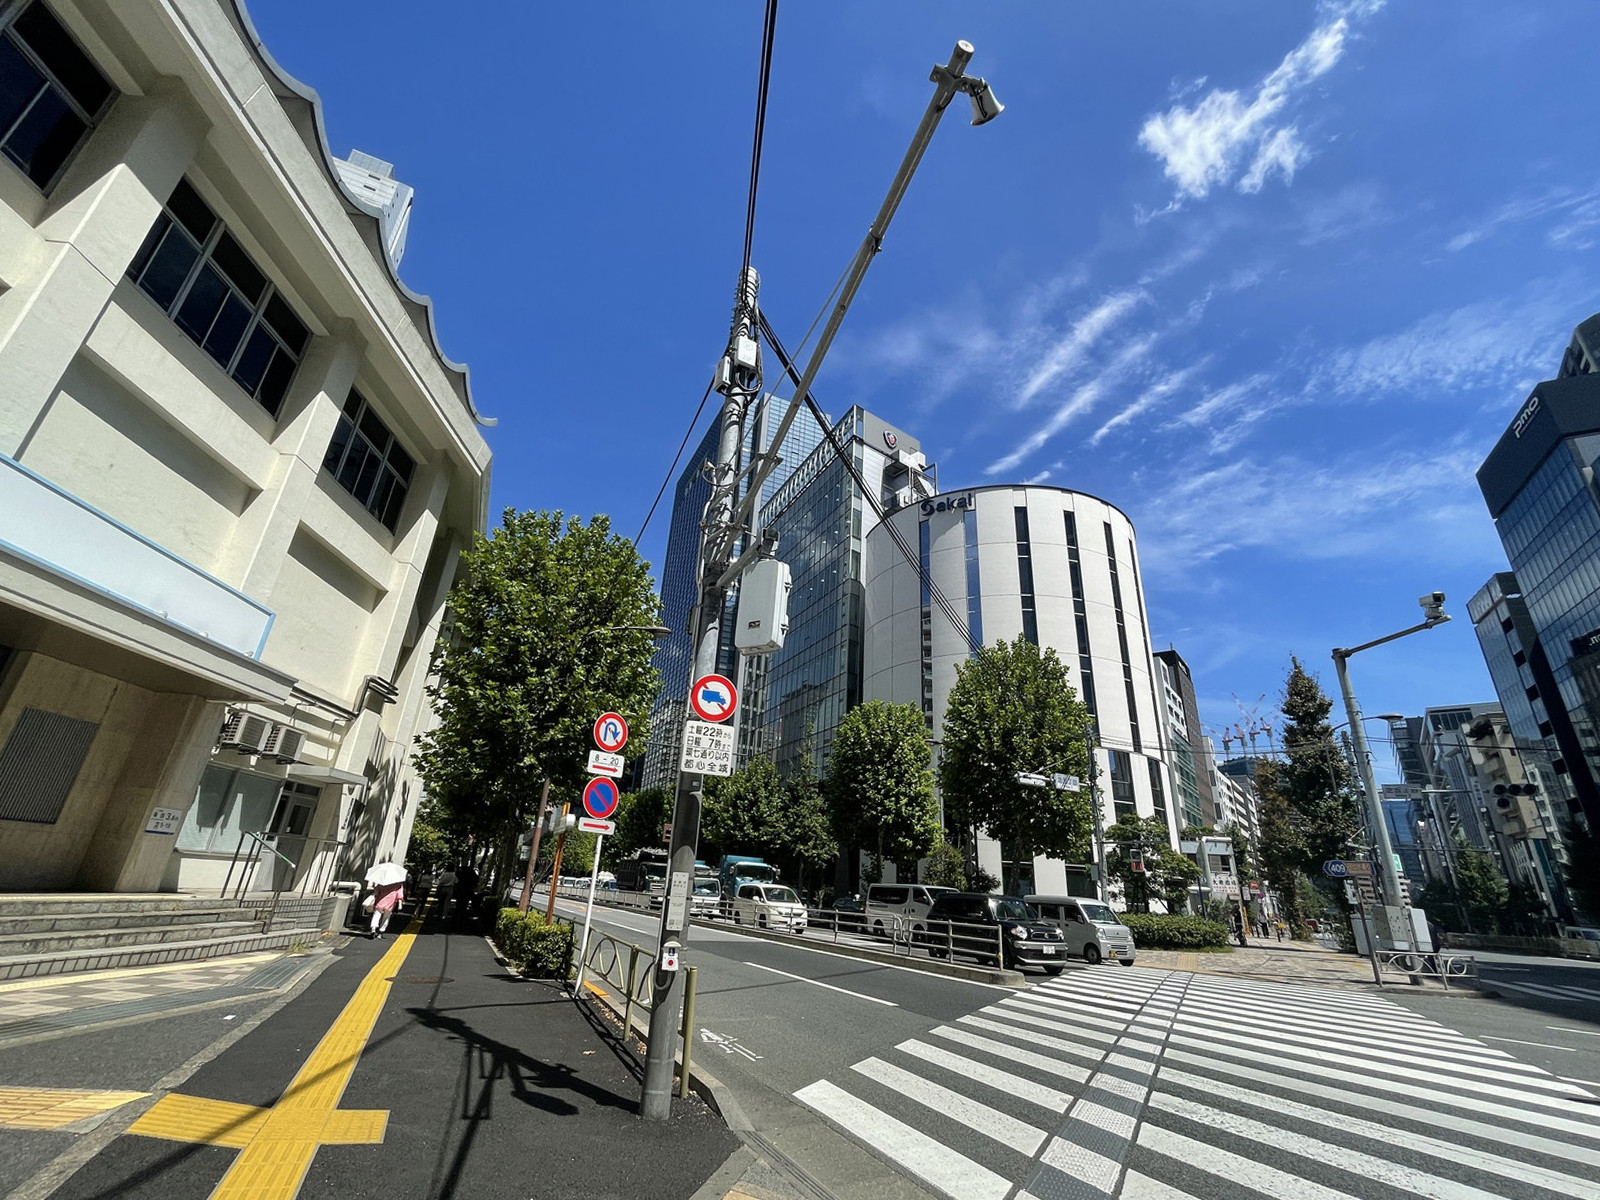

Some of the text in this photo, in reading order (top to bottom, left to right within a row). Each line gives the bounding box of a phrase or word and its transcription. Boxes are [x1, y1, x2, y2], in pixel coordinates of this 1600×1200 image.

[688, 725, 732, 740] 土曜22時から
[684, 759, 729, 773] 都心全域
[1331, 863, 1346, 872] 409
